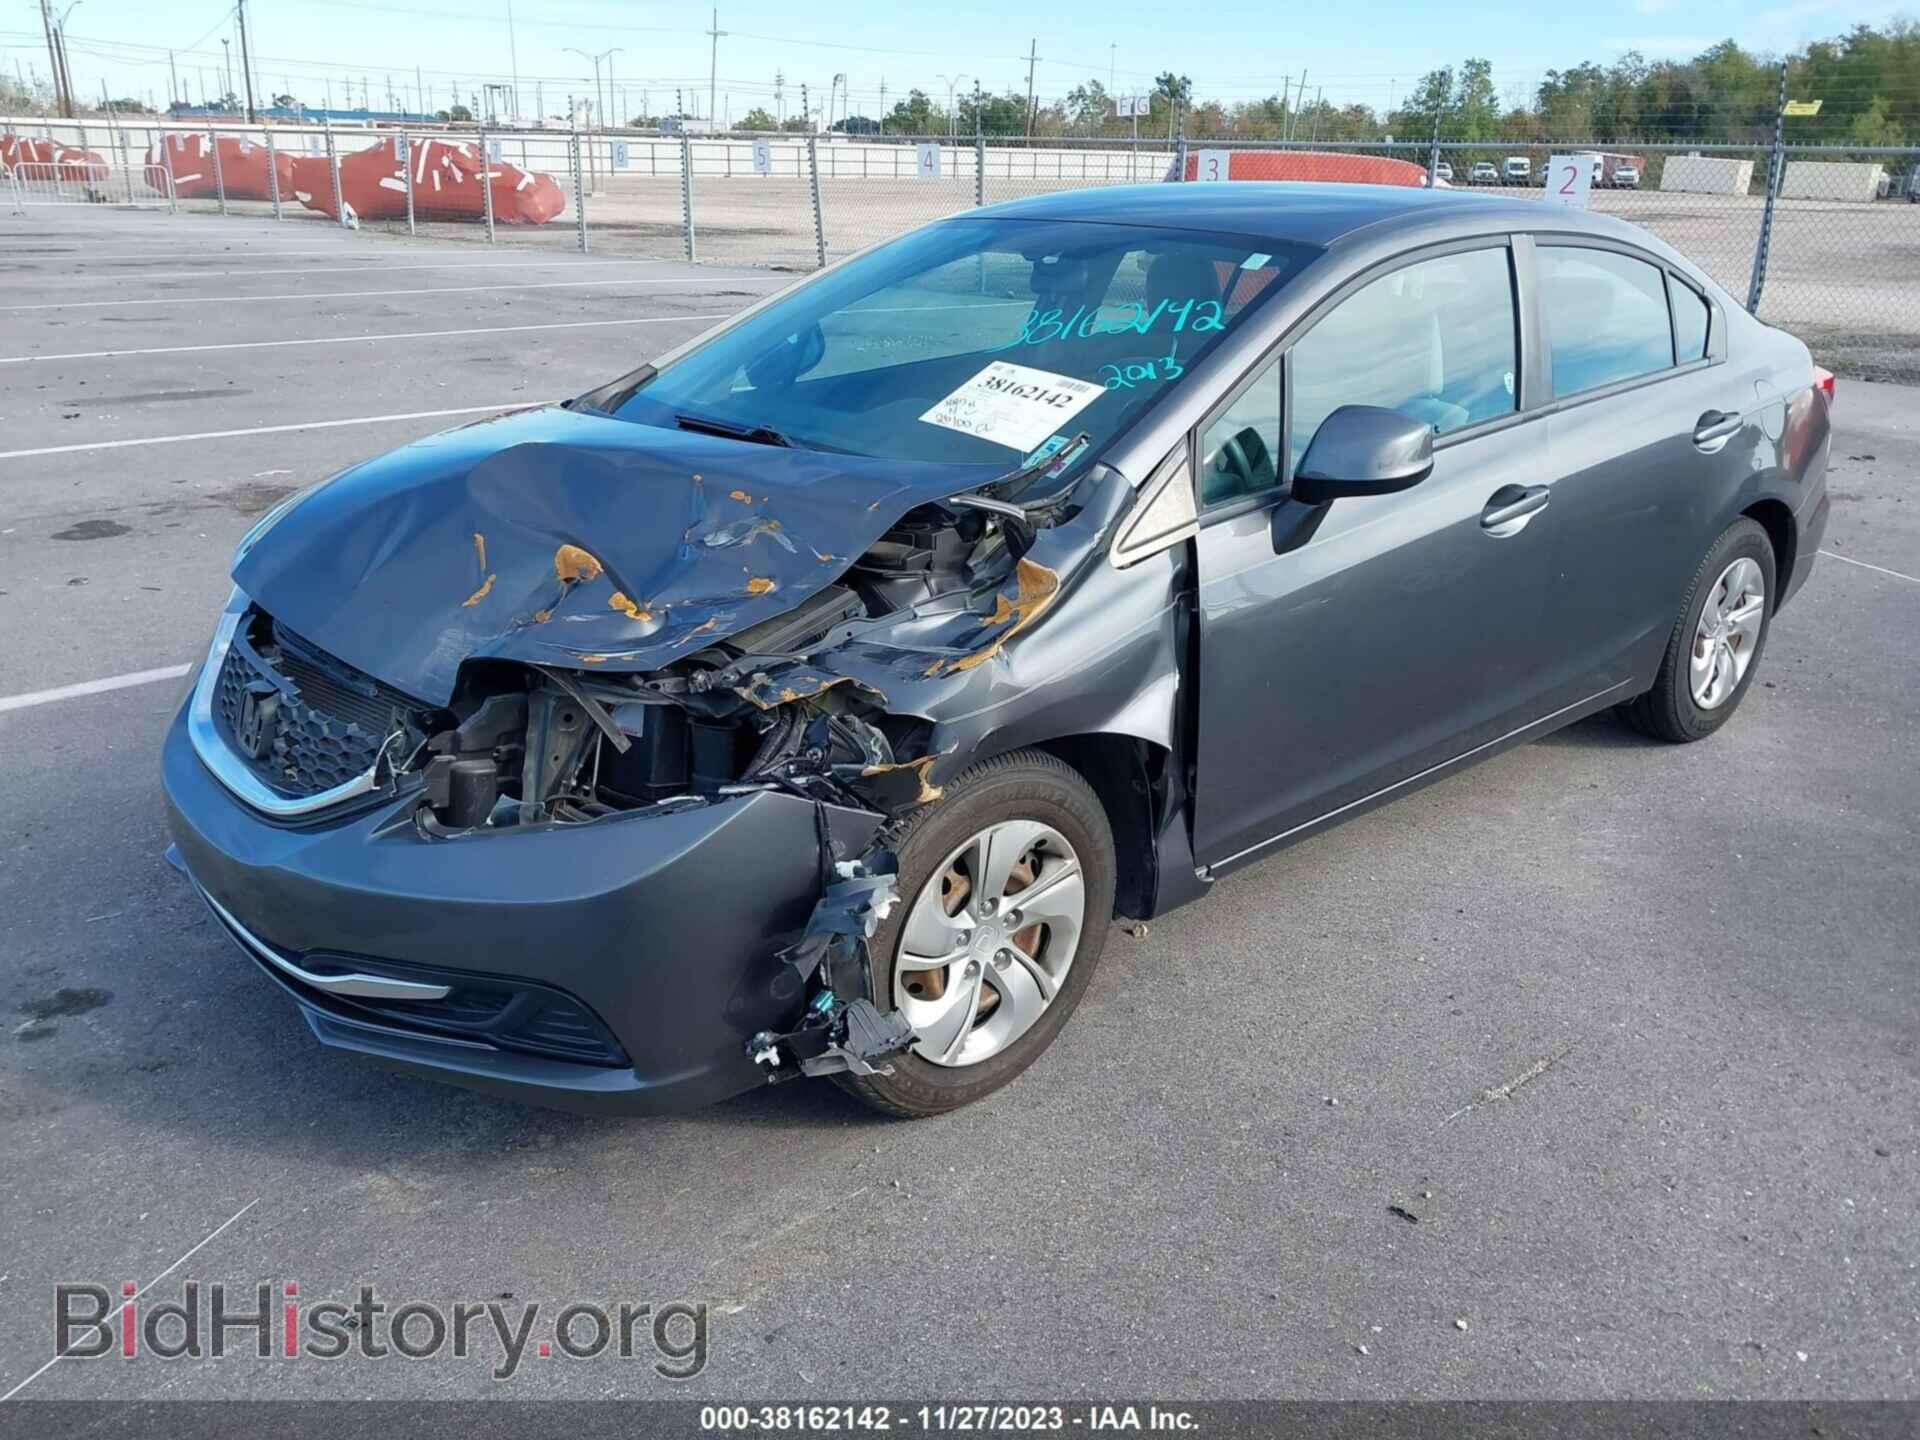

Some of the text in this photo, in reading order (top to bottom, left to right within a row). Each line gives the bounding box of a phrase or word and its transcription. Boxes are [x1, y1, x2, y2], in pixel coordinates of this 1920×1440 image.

[617, 145, 625, 163] 6
[758, 147, 766, 166] 5
[923, 149, 934, 171] 4
[1207, 158, 1218, 182] 3
[1559, 165, 1577, 195] 2
[992, 298, 1225, 351] 38162142
[1098, 355, 1184, 390] 2013
[978, 375, 1074, 408] 38162142
